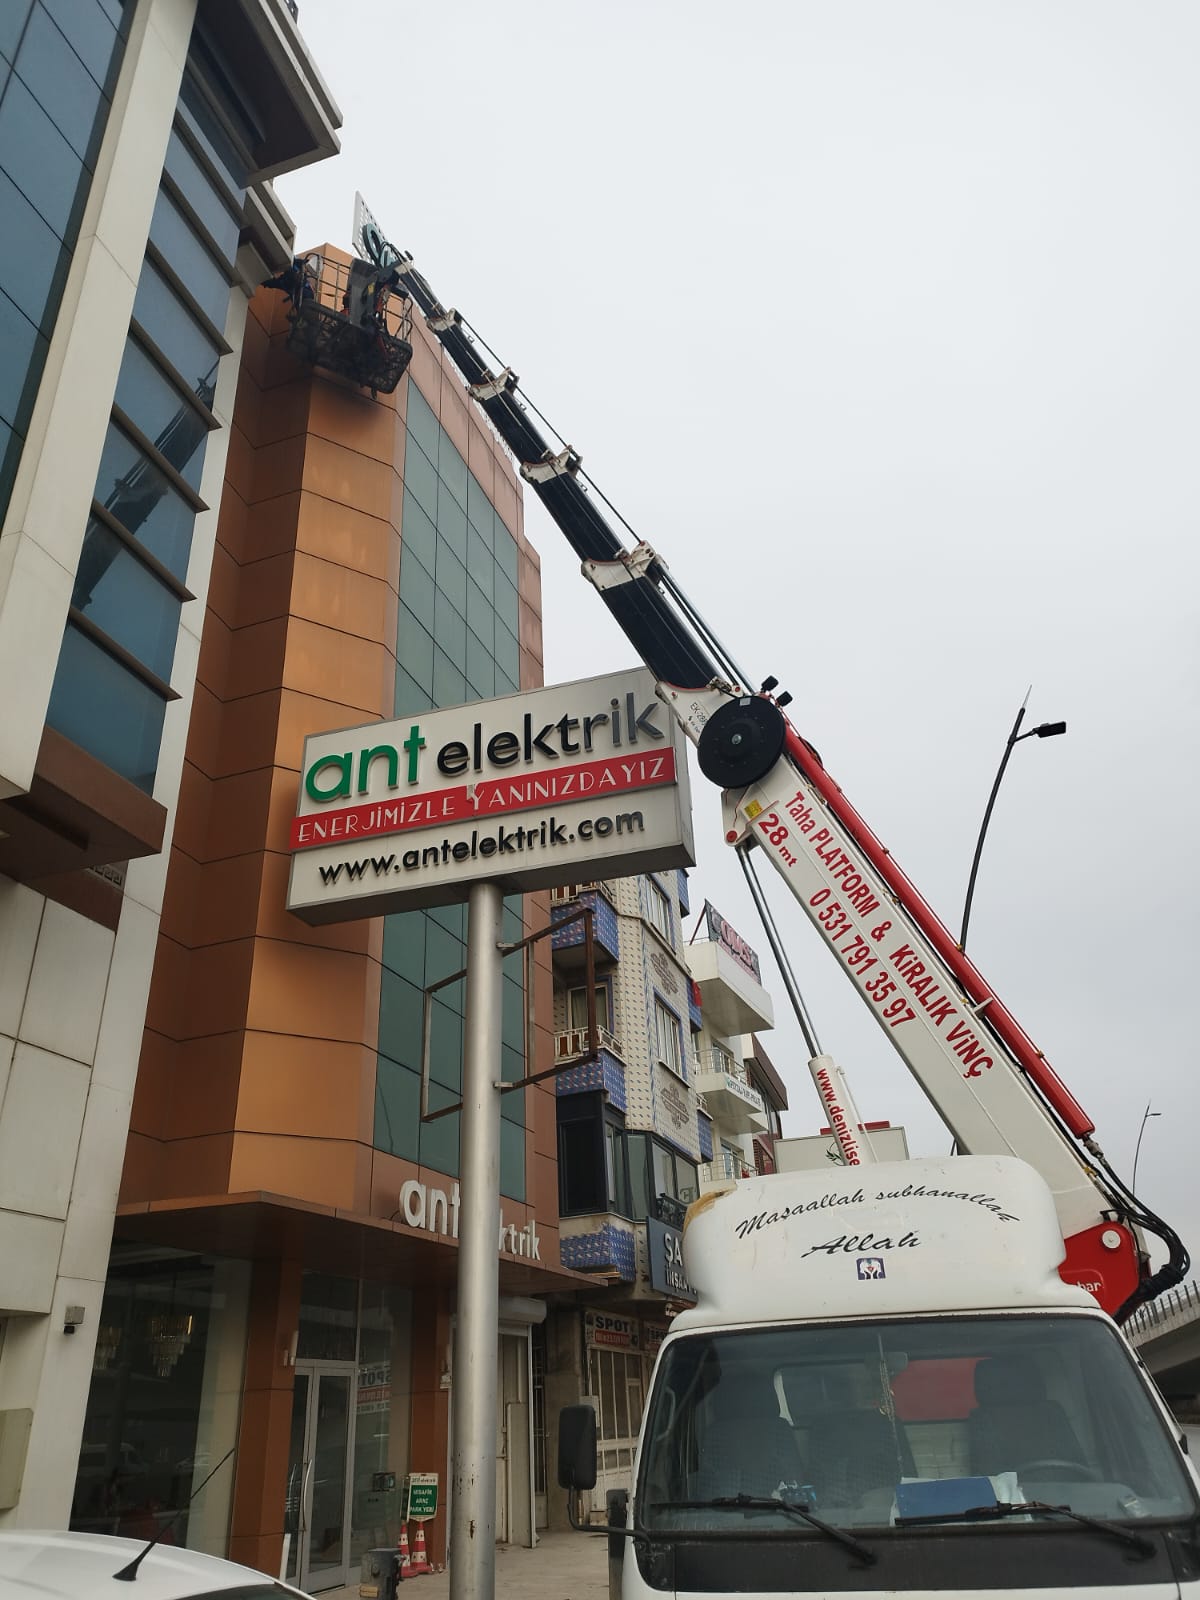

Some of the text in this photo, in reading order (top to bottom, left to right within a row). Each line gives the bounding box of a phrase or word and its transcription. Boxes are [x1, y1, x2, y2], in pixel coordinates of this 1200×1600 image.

[305, 692, 665, 803] ant elektrik
[297, 756, 666, 843] ENERJİMİZLE YANINIZDAYIZ
[319, 810, 645, 885] www.antelektrik.com
[758, 813, 798, 867] 28 mt
[785, 791, 816, 834] Taha
[808, 828, 881, 918] PLATFORM
[870, 921, 892, 942] &
[809, 888, 916, 1028] 0 531 791 35 97
[399, 1179, 541, 1261] ant ktrik
[875, 1184, 1020, 1222] subhanallah
[800, 1230, 921, 1258] Allah
[595, 1315, 630, 1333] SPOT
